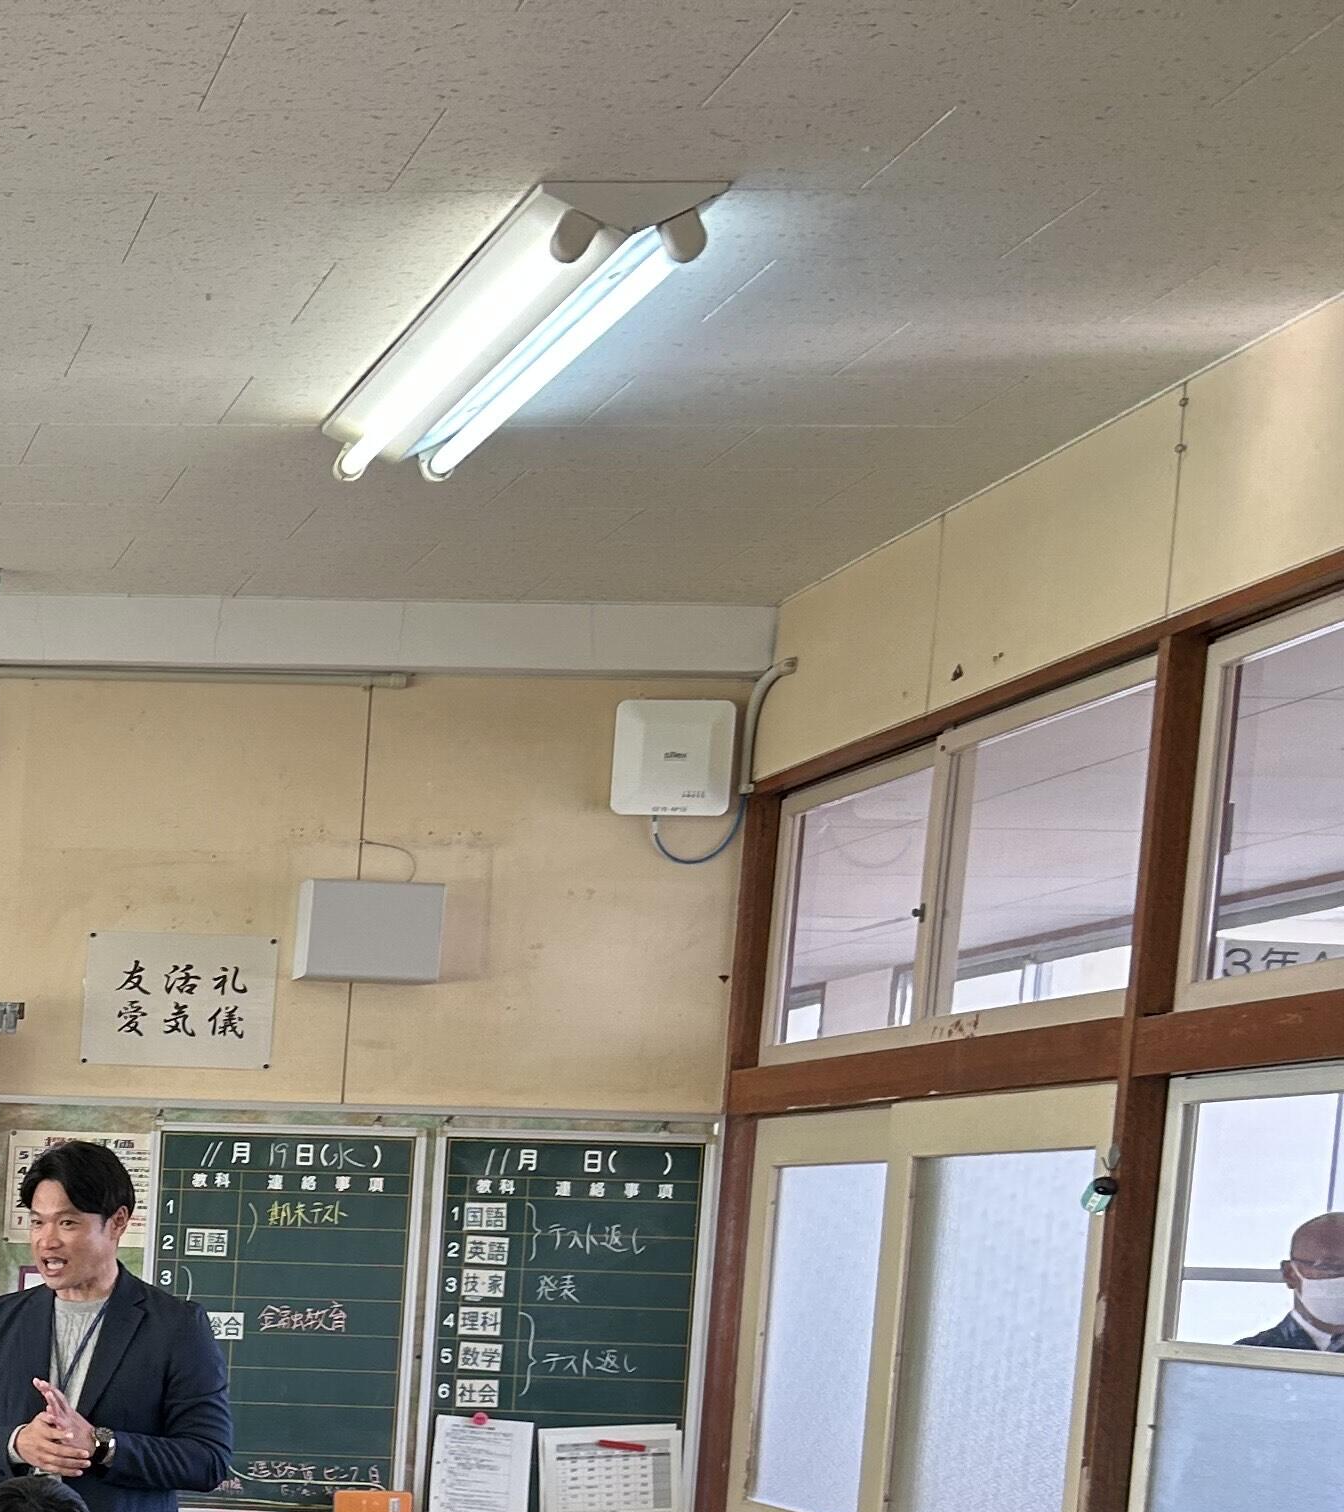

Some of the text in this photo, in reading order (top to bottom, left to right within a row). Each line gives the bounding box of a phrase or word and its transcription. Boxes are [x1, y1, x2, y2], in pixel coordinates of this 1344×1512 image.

[18, 1150, 29, 1160] 5
[191, 1172, 231, 1189] 教科
[266, 1174, 385, 1193] 連絡事項
[475, 1179, 516, 1195] 教科
[554, 1181, 674, 1199] 連絡事項
[165, 1199, 175, 1215] 1
[266, 1200, 349, 1227] 期末テスト
[450, 1206, 460, 1222] 1
[465, 1206, 507, 1229] 国語
[161, 1234, 175, 1250] 2
[186, 1231, 227, 1254] 国語
[547, 1222, 647, 1256] テスト返し
[446, 1242, 460, 1257] 2
[466, 1239, 508, 1263] 英語
[160, 1270, 172, 1286] 3
[444, 1277, 458, 1293] 3
[535, 1273, 580, 1304] 発表
[257, 1300, 348, 1333] 金融教育
[442, 1312, 456, 1328] 4
[459, 1310, 502, 1332] 理科
[439, 1348, 453, 1364] 5
[461, 1346, 502, 1368] 数学
[541, 1348, 638, 1377] テスト返し
[437, 1382, 450, 1398] 6
[457, 1382, 498, 1404] 社会
